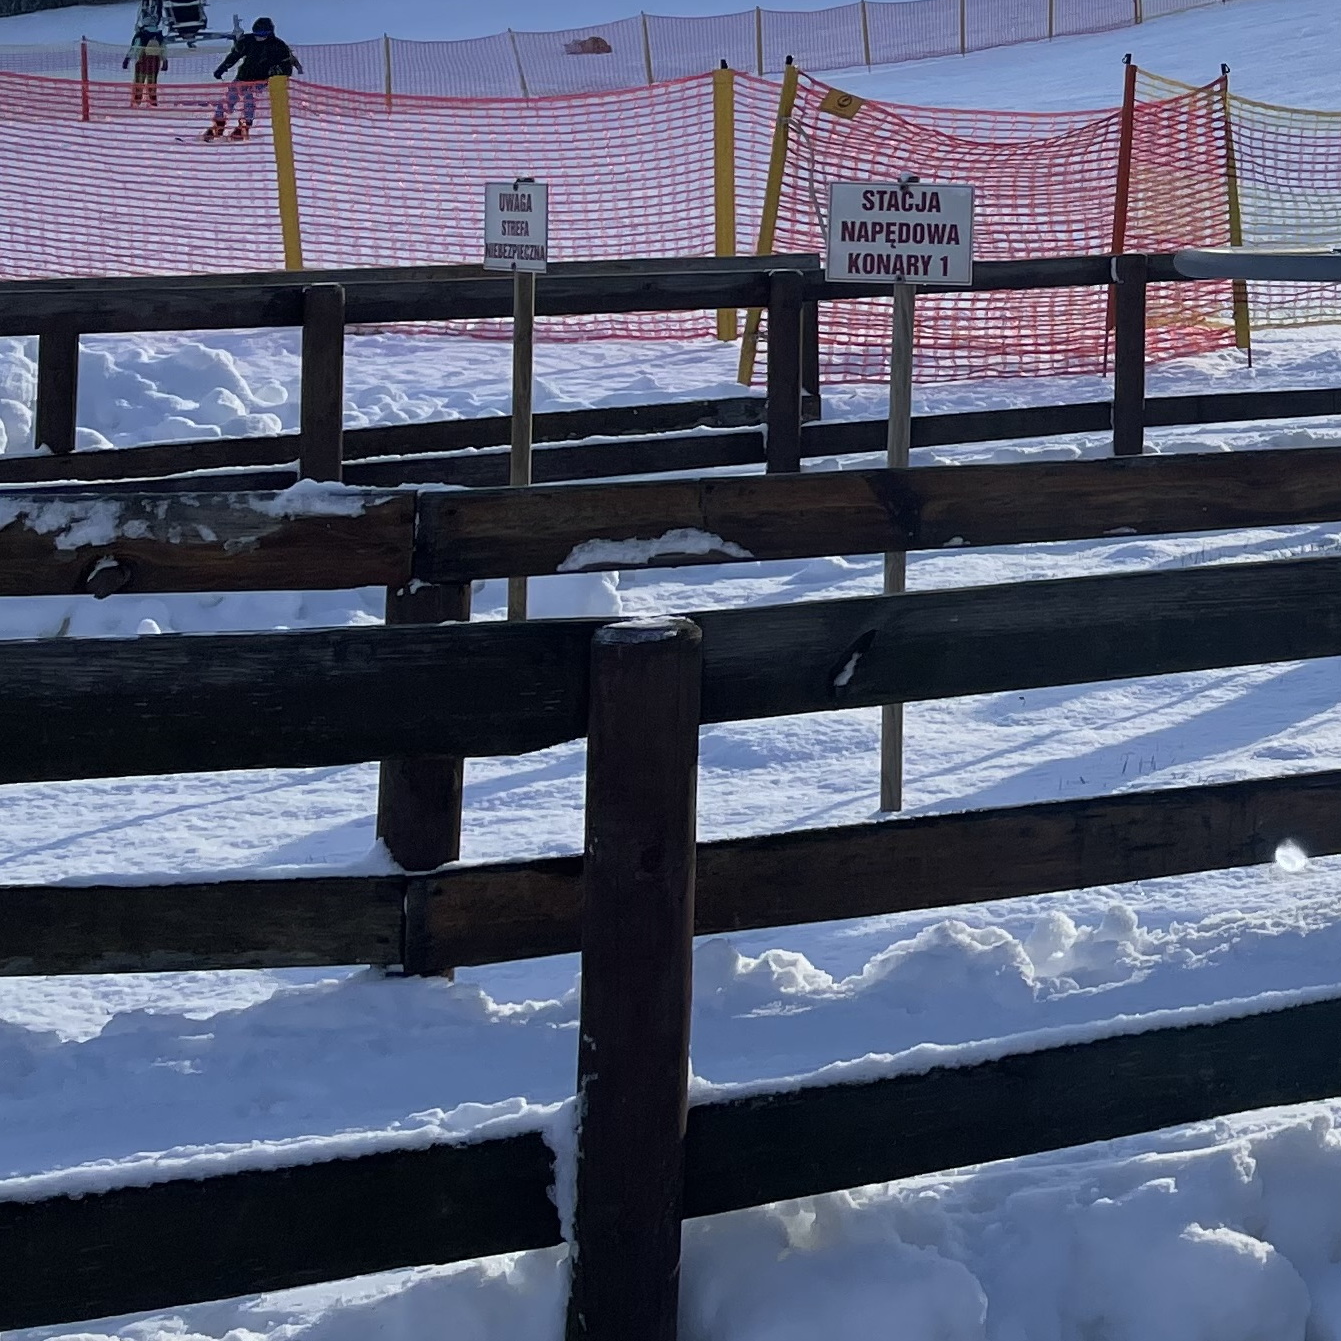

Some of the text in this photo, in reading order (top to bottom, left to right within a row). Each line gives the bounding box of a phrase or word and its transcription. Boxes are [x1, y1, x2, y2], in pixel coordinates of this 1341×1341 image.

[499, 193, 532, 212] UWAGA
[862, 190, 941, 213] STACJA
[501, 220, 529, 236] STREFA
[841, 221, 960, 248] NAPĘDOWA
[485, 242, 545, 260] NIEBEZPIECZNA
[848, 253, 948, 276] KONARY 1
